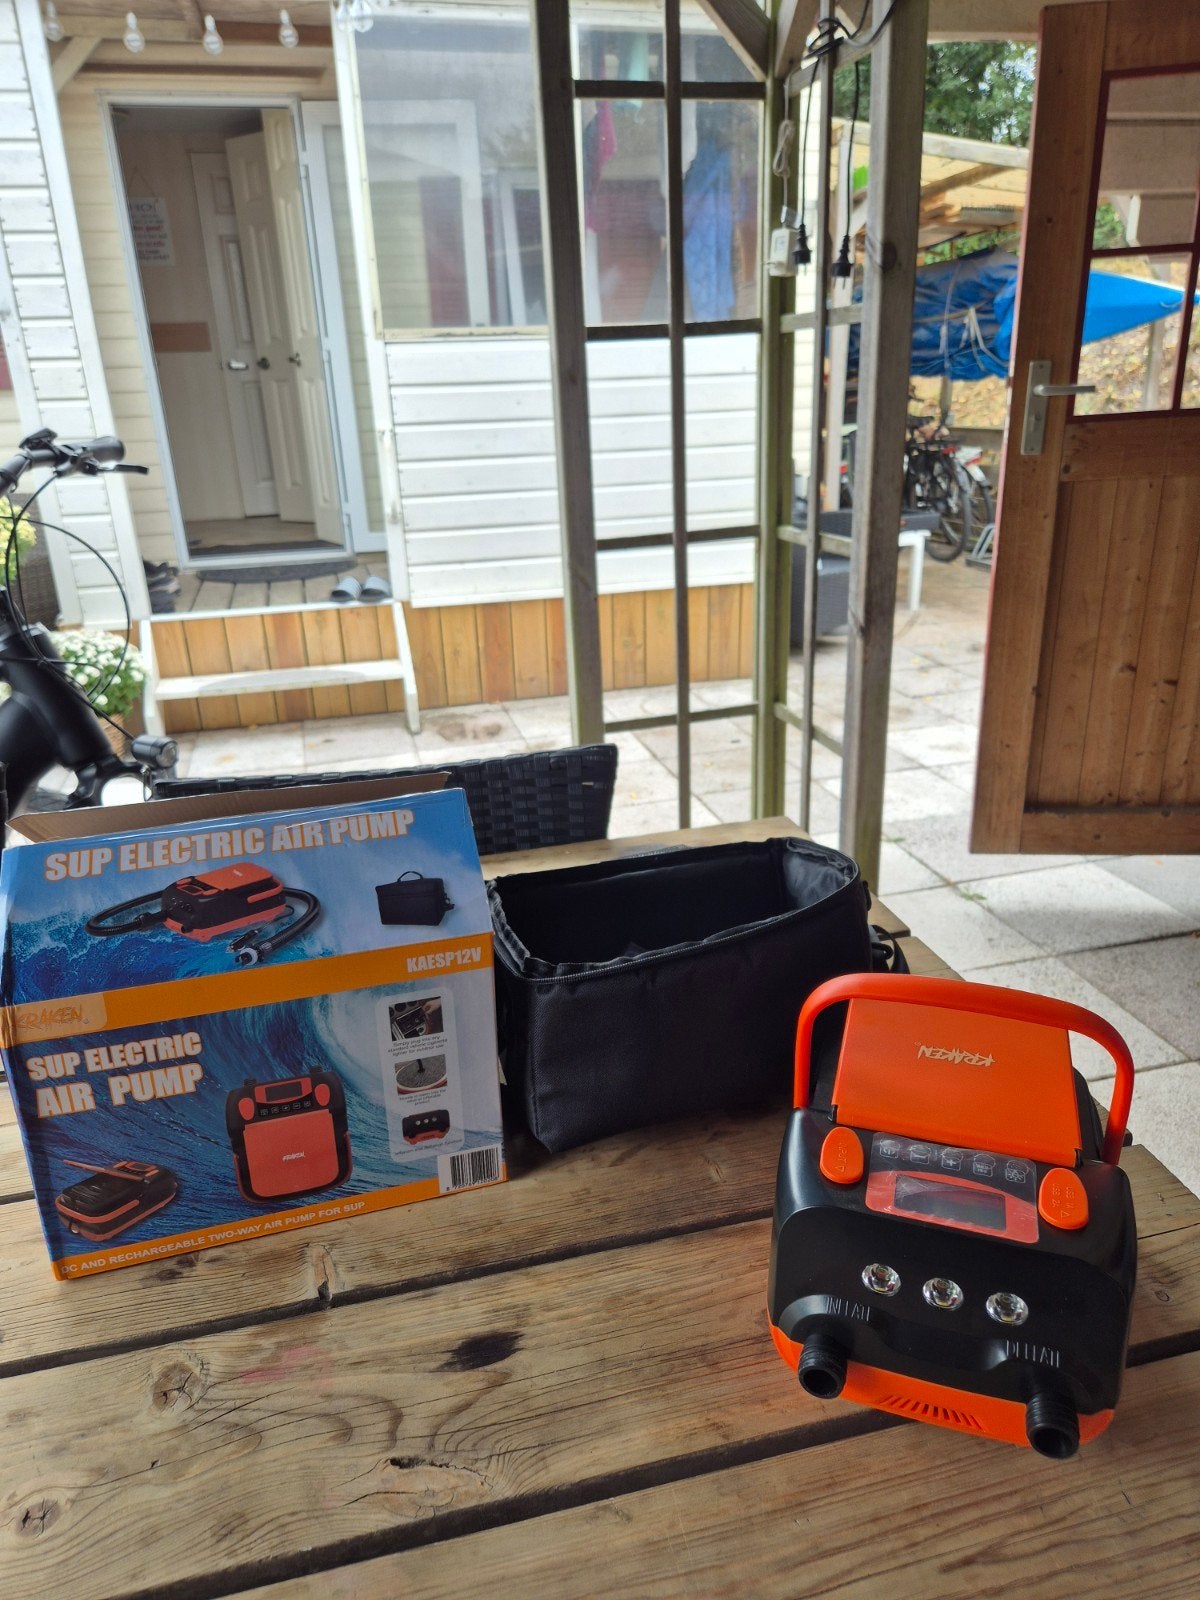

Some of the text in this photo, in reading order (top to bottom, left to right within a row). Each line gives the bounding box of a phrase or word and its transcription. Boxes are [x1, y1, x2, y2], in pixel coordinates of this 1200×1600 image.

[45, 809, 414, 882] SUP ELECTRIC AIR PUMP
[406, 946, 482, 973] KAESP12V
[26, 1031, 202, 1081] SUP ELECTRIC
[917, 1044, 996, 1067] KRAKEN
[36, 1063, 203, 1118] AIR PUMP
[80, 1258, 106, 1271] AND
[109, 1236, 206, 1264] RECHARGEABLE
[207, 1225, 261, 1242] TWO-WAY
[263, 1219, 283, 1230] AIR
[285, 1212, 316, 1226] PUMP
[318, 1206, 342, 1218] FOR
[344, 1201, 366, 1213] SUP
